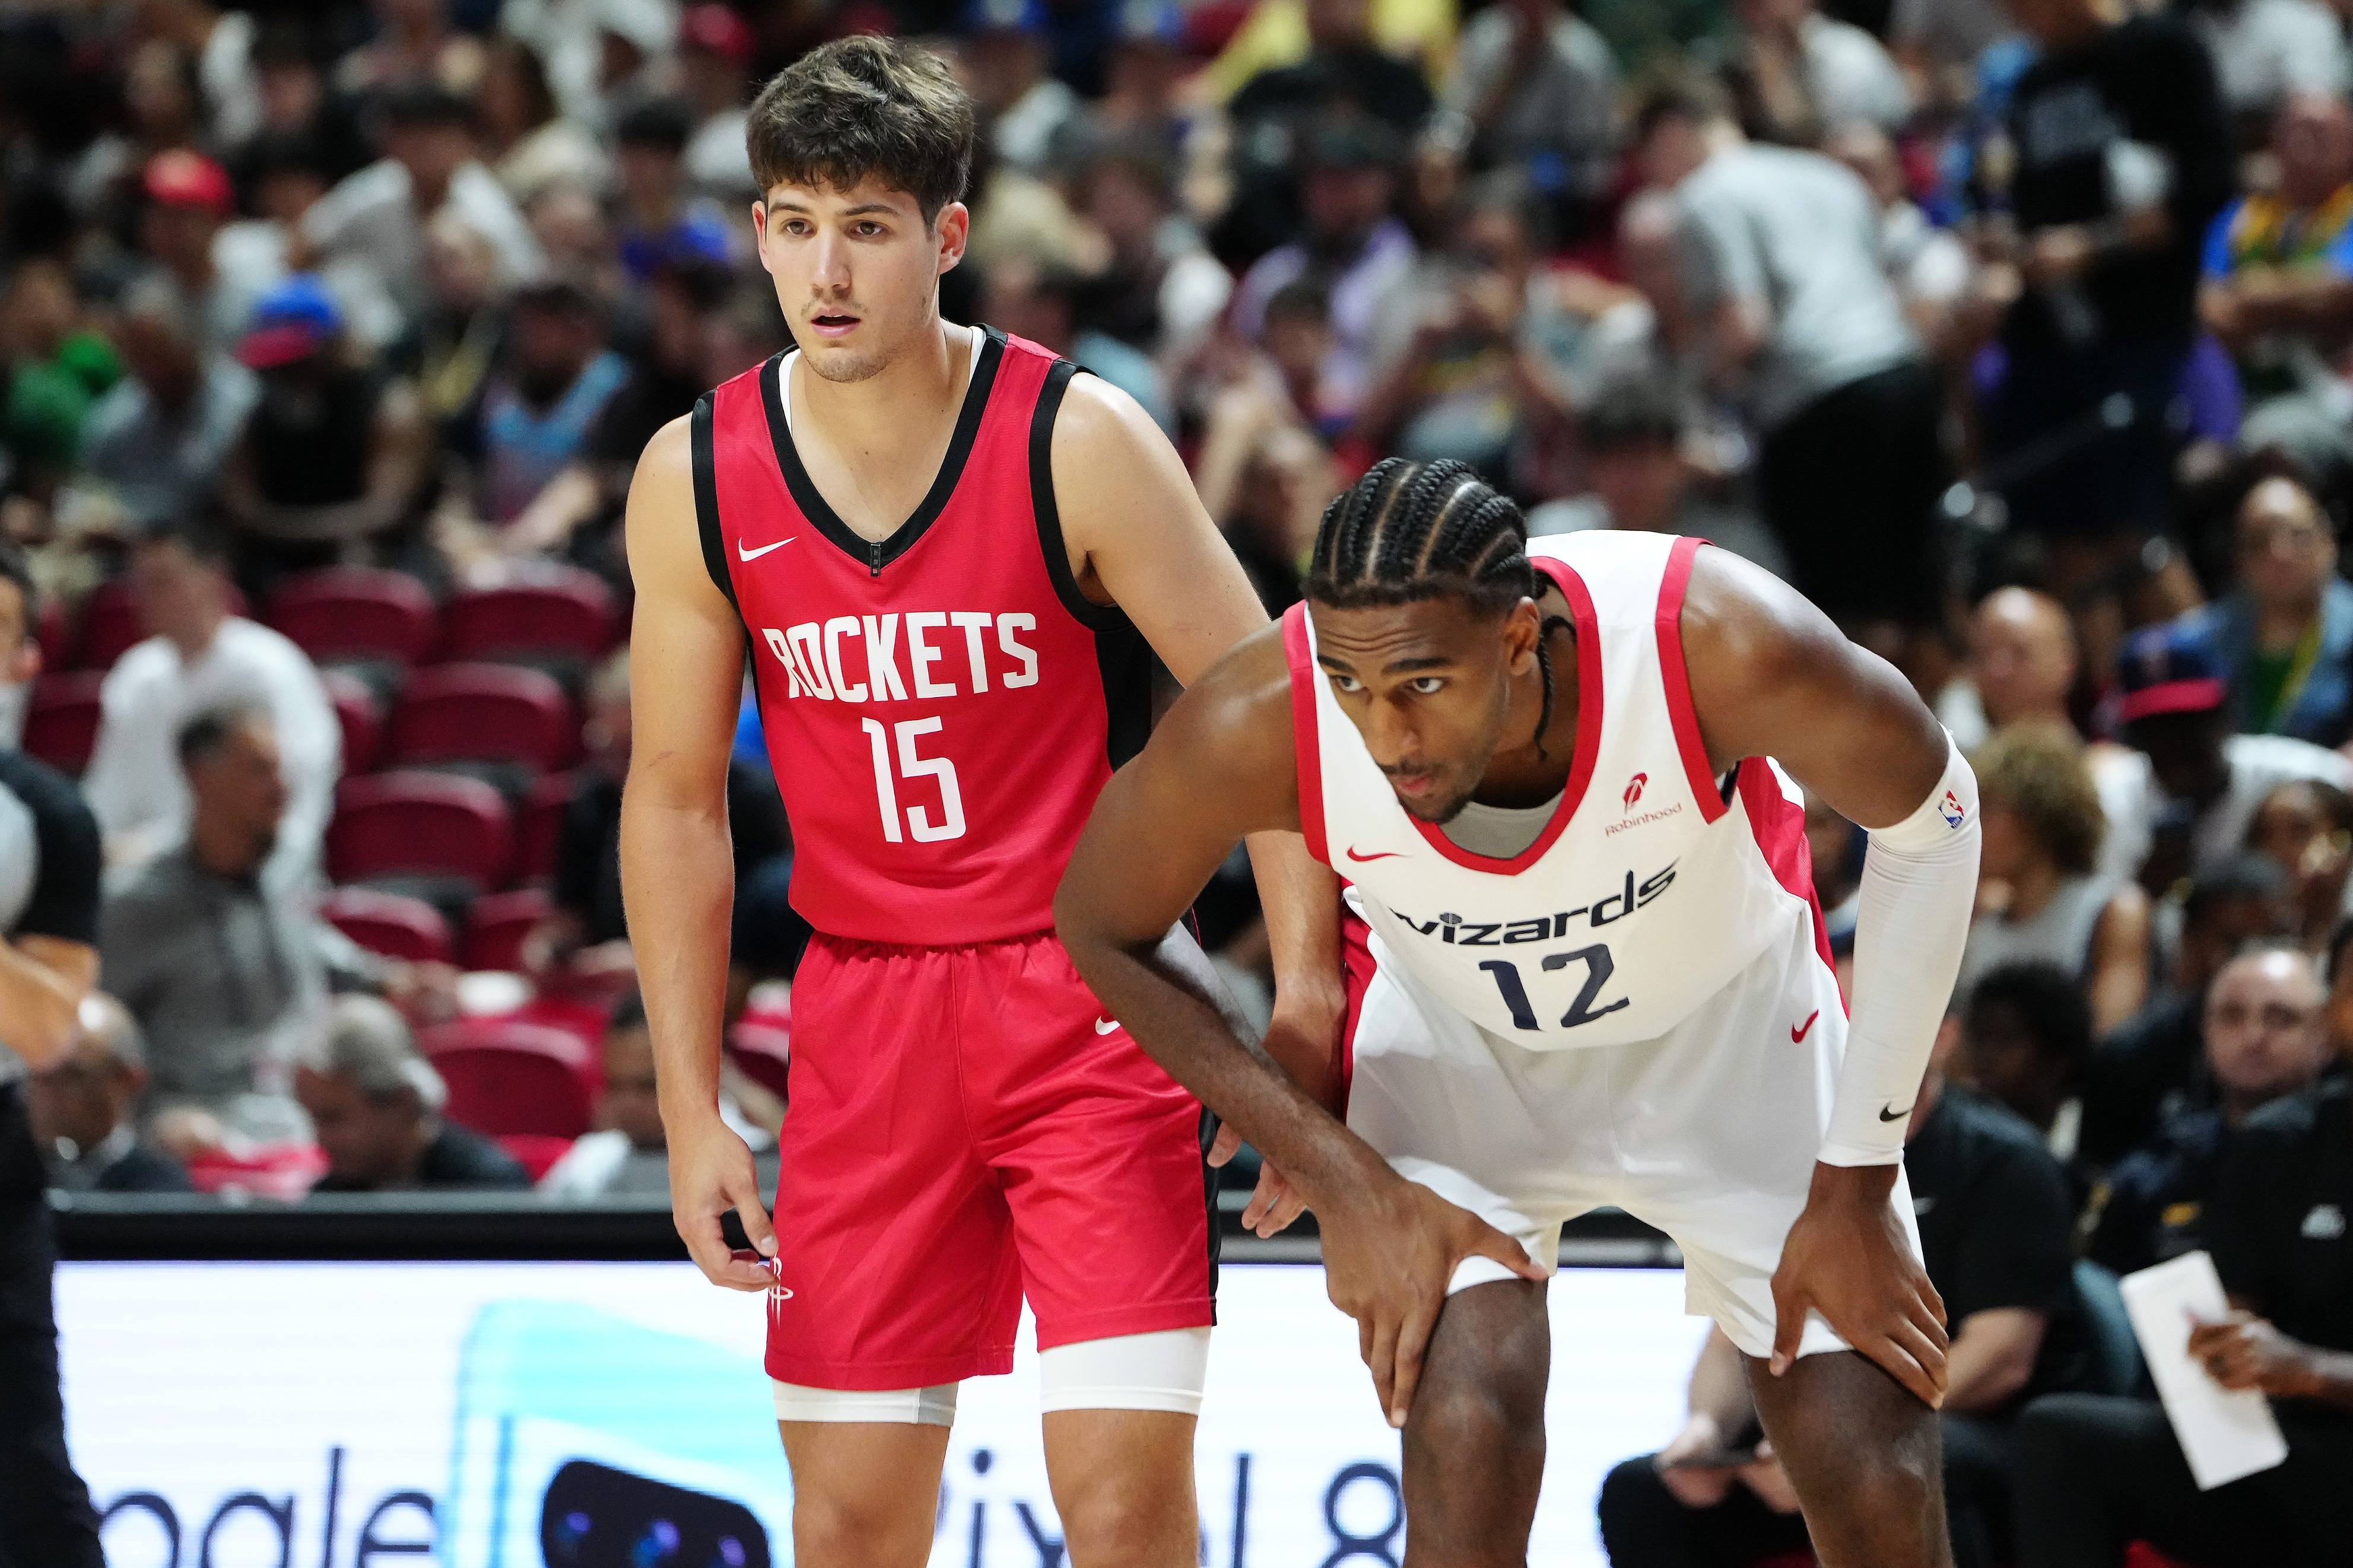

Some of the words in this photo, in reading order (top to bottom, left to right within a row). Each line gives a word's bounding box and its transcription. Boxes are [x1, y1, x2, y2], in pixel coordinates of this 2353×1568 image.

[761, 610, 1040, 703] ROCKETS
[861, 715, 967, 844] 15
[1605, 802, 1683, 837] Robinhood
[1387, 855, 1682, 946] wizards
[1478, 943, 1631, 1032] 12
